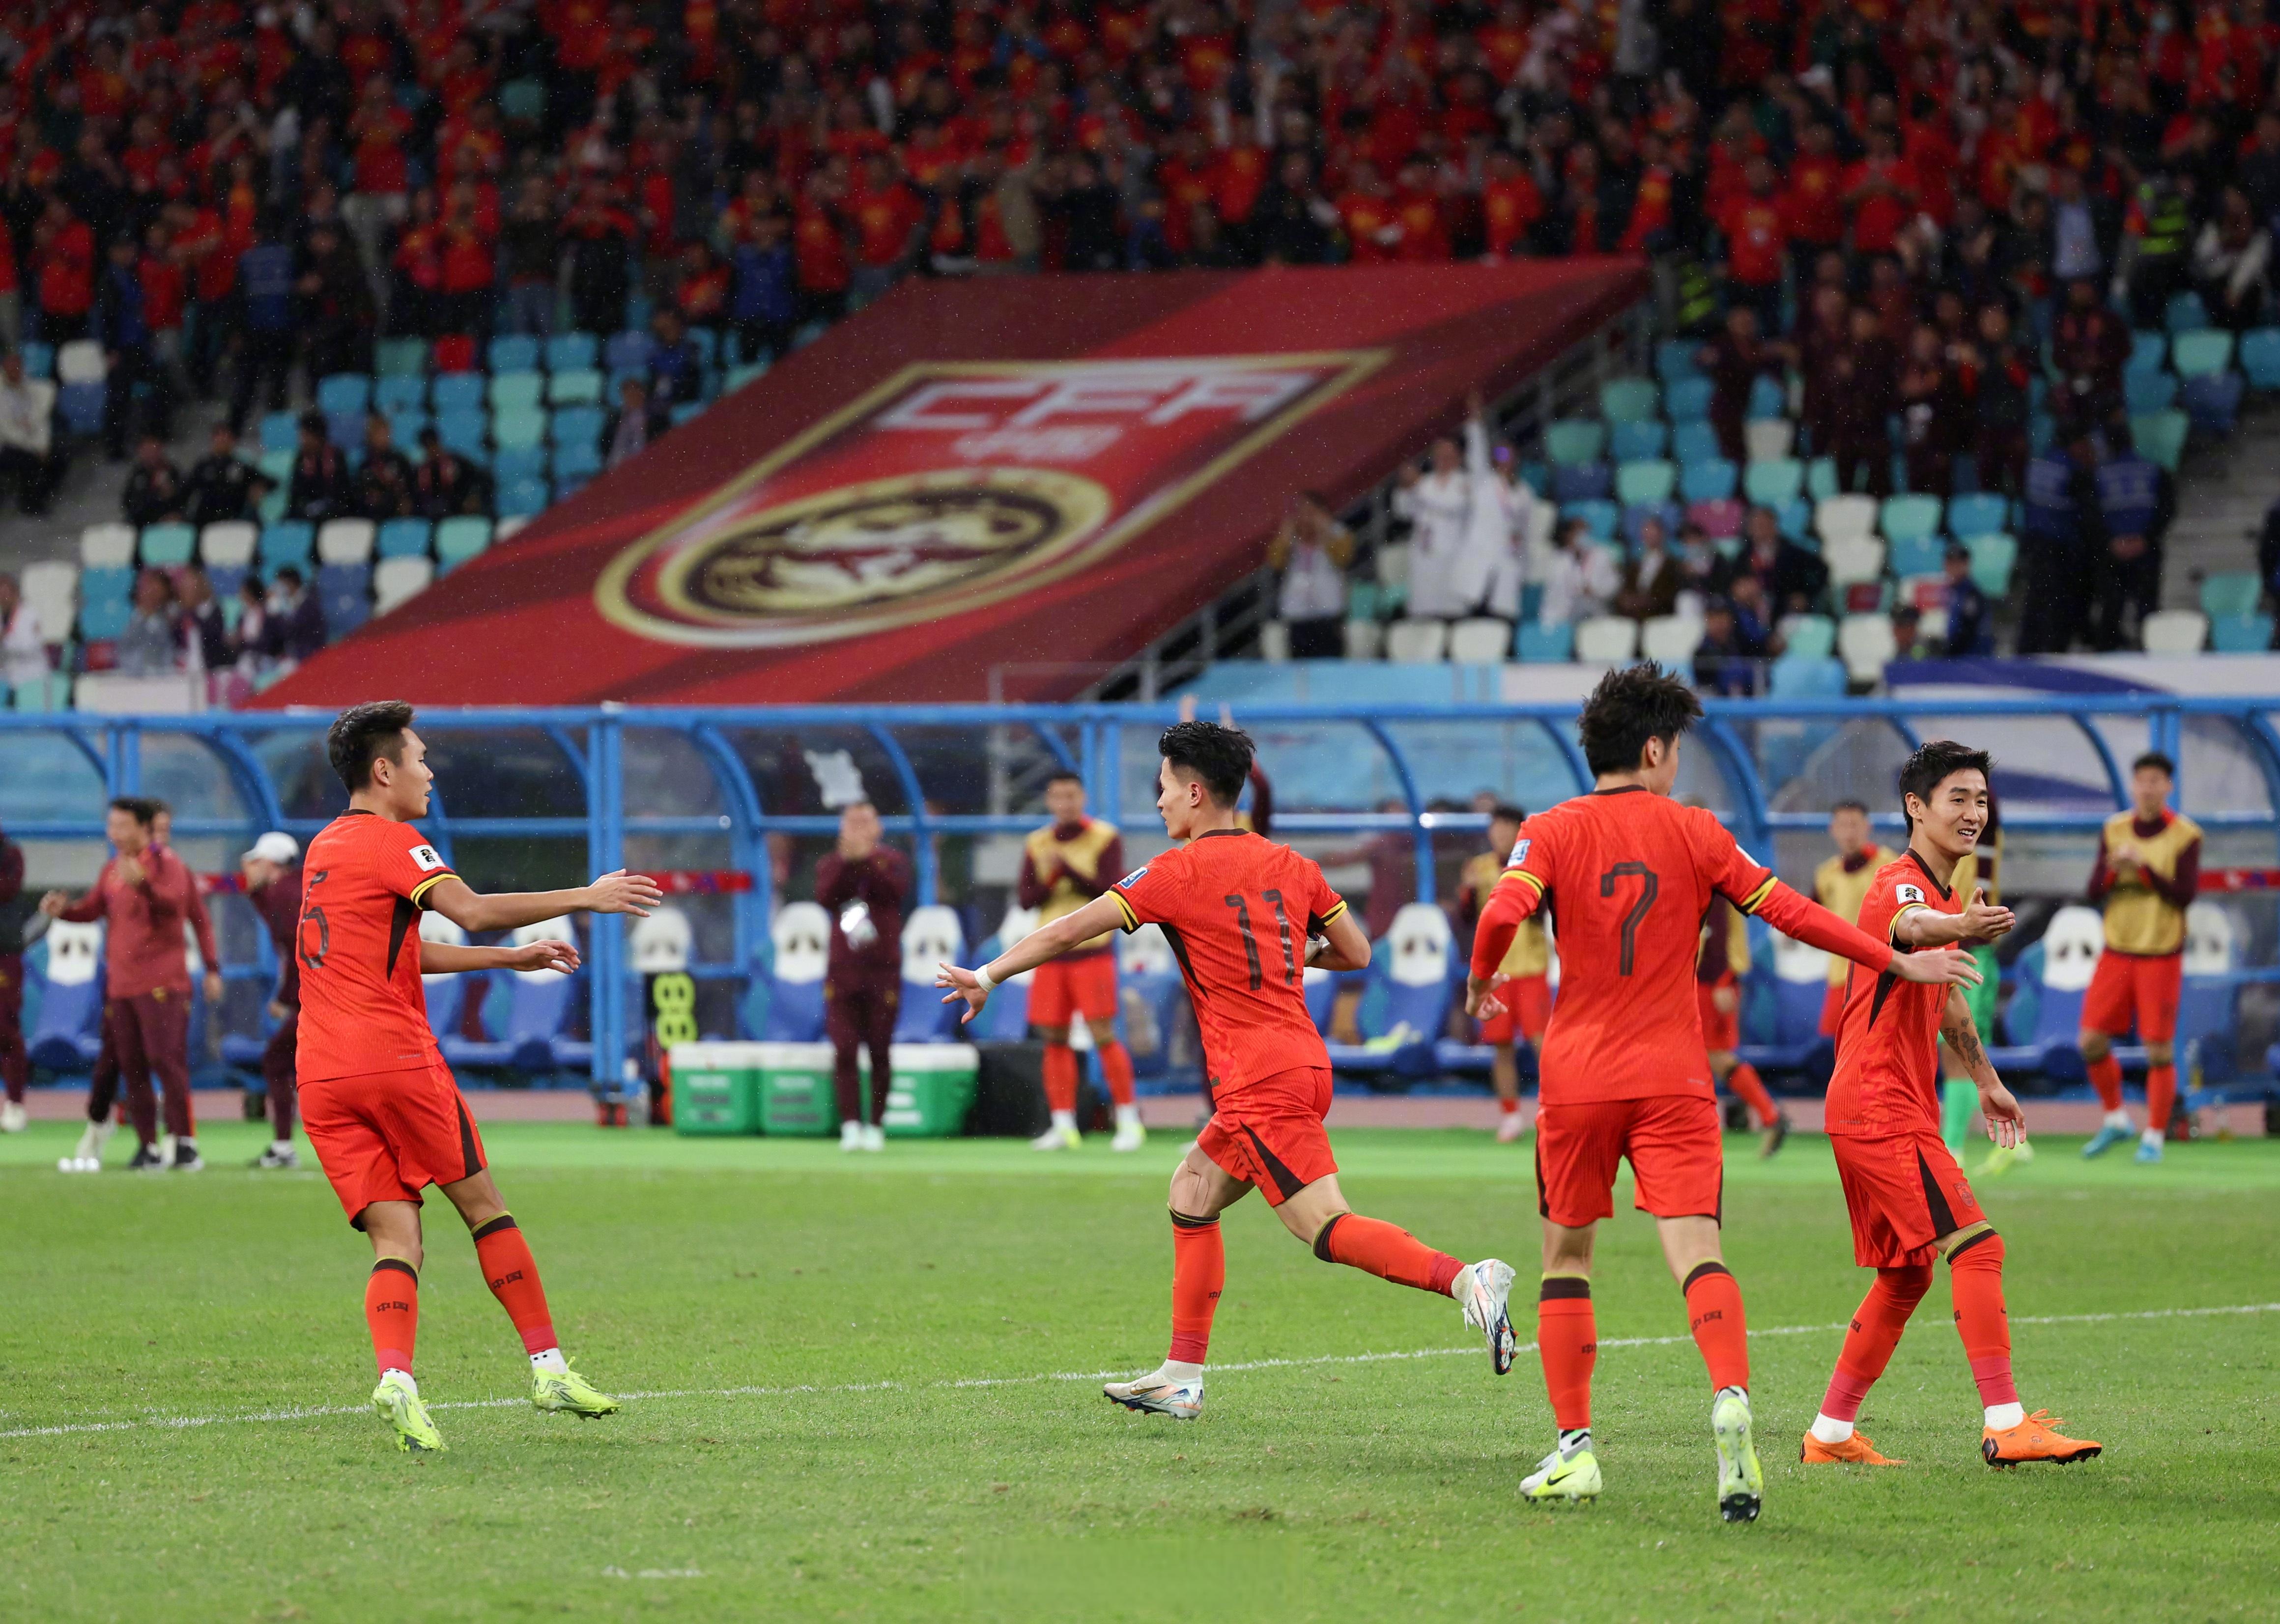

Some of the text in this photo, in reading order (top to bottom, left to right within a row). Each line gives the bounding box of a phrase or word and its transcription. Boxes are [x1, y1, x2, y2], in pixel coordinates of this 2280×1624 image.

[876, 371, 1318, 428] CFA
[1225, 889, 1296, 991] 11
[1600, 861, 1658, 977] 7
[376, 1301, 409, 1313] 中国
[492, 1270, 523, 1289] 中国
